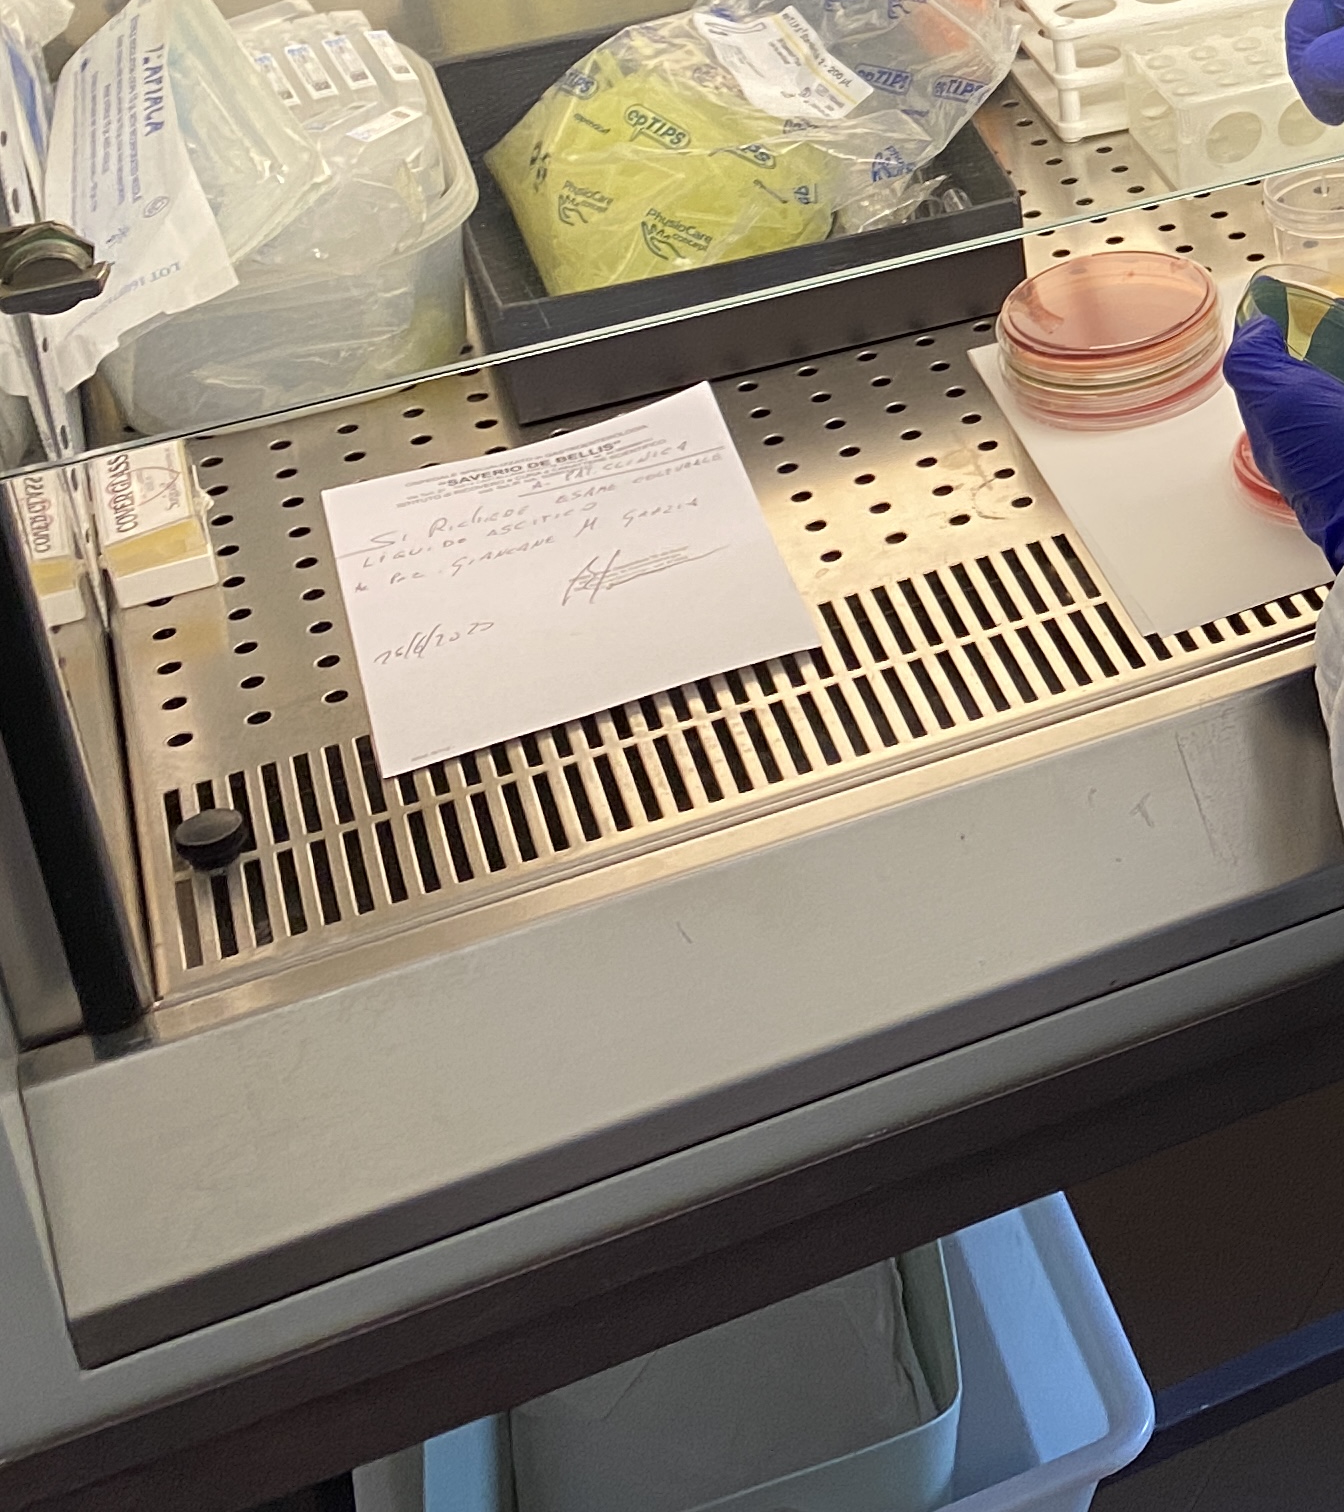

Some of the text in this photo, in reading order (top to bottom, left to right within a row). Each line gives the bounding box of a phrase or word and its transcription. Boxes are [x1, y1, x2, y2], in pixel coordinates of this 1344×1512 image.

[827, 66, 844, 80] 200
[627, 109, 686, 145] epTIPS
[646, 208, 713, 242] PhysioCare
[527, 460, 550, 469] DE
